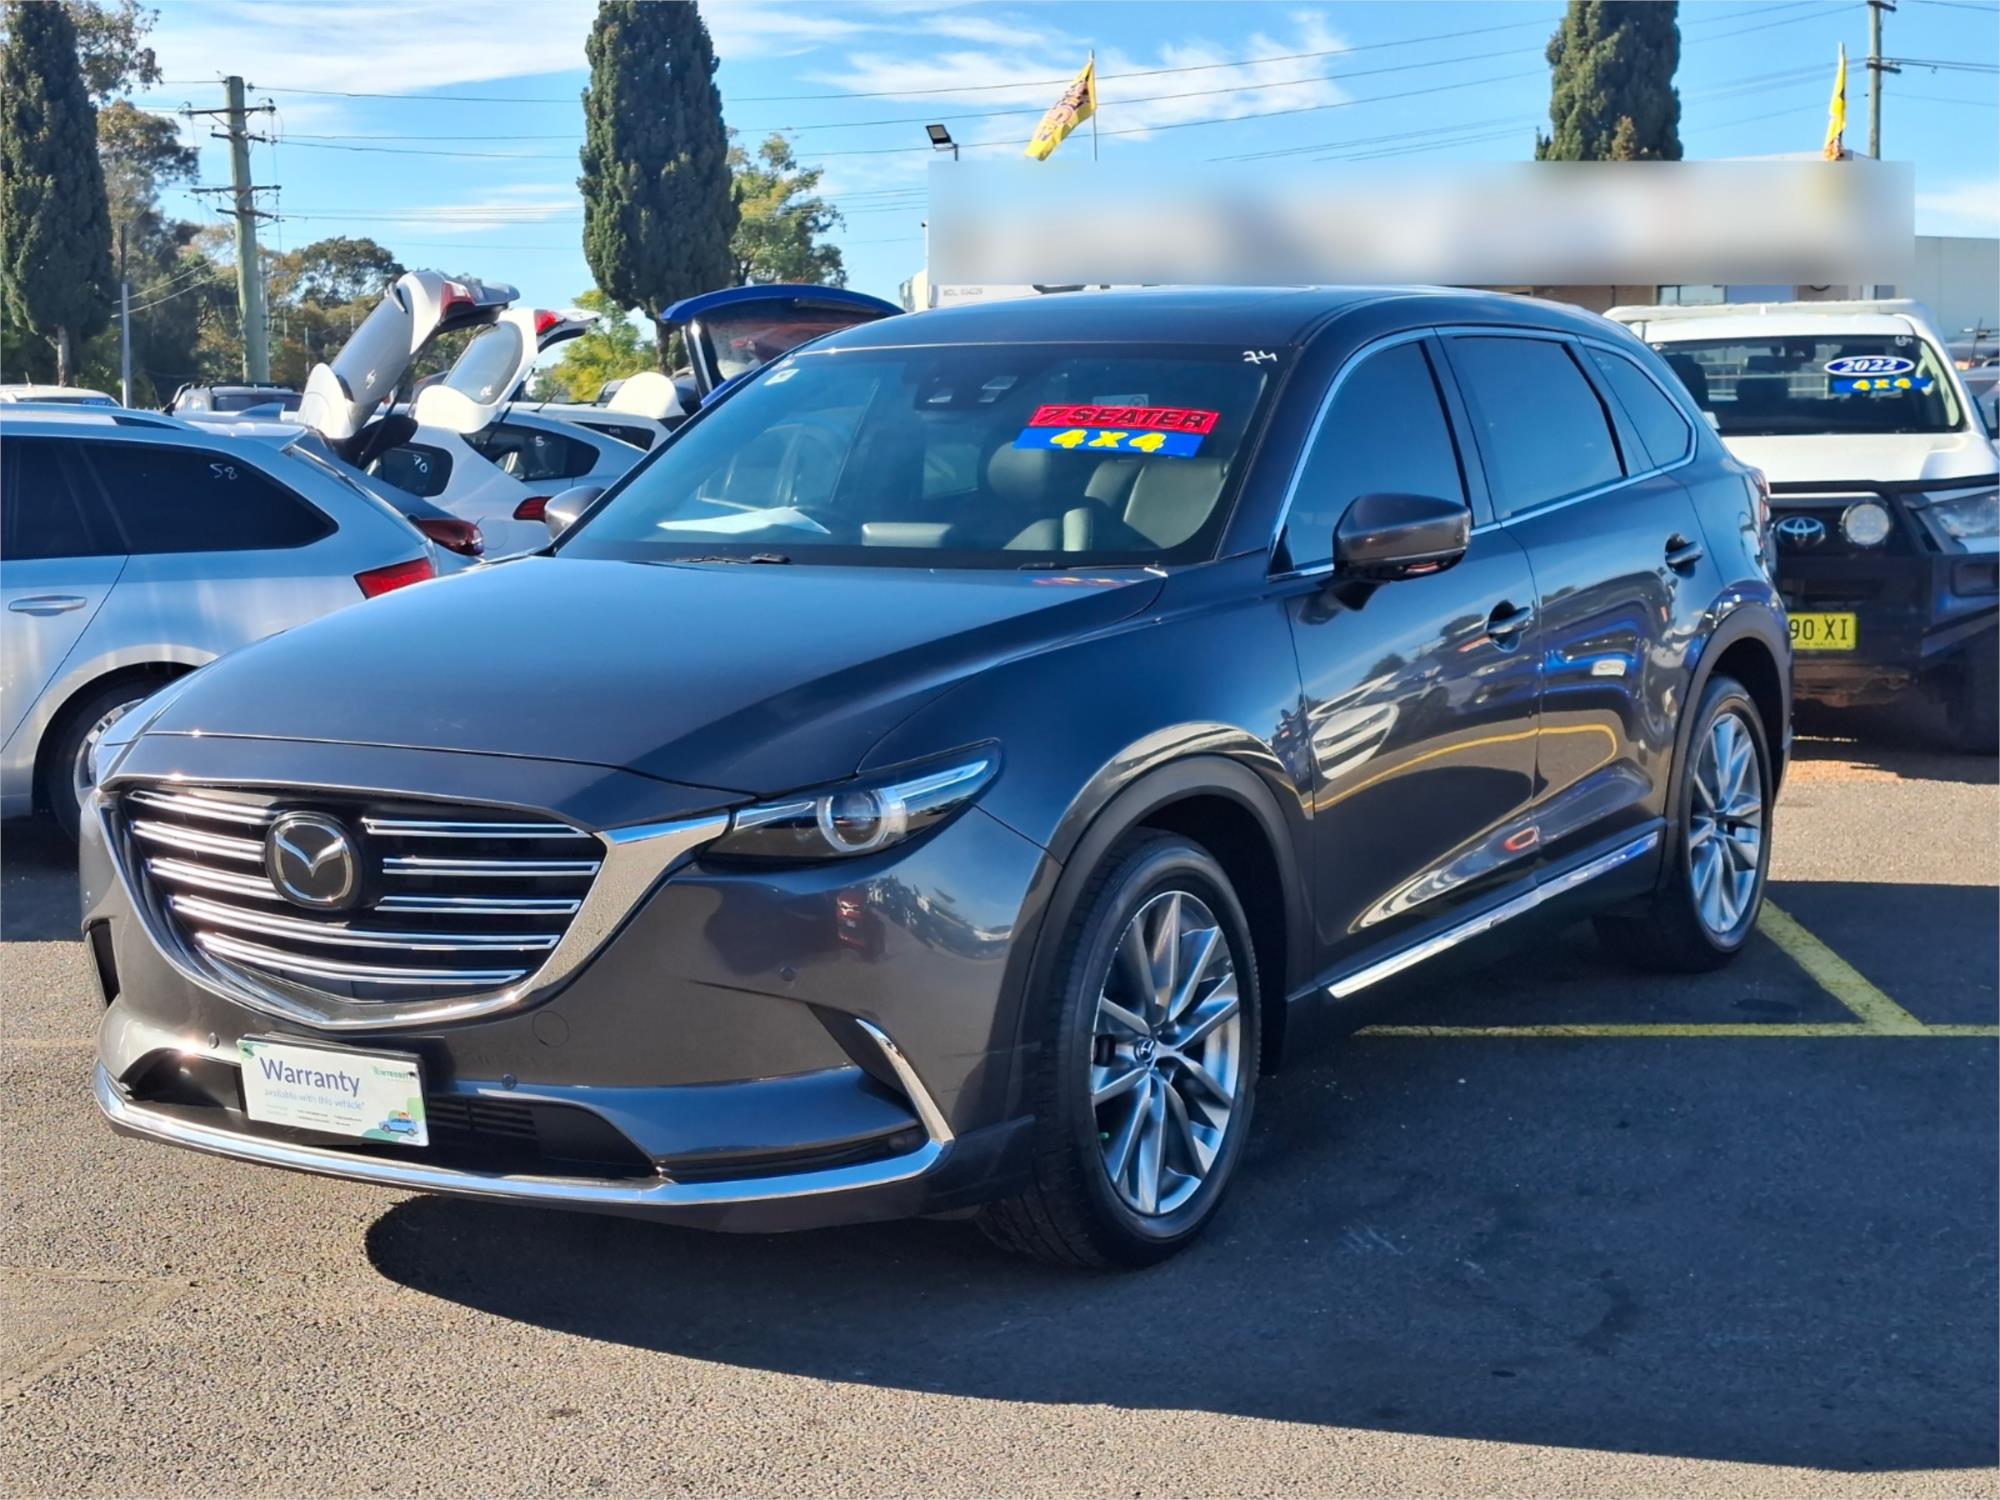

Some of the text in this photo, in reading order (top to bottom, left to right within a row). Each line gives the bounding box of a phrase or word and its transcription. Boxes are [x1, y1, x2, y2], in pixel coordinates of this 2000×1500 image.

[1840, 359, 1898, 372] 2022
[1038, 407, 1207, 429] 7 SEATER
[209, 463, 238, 480] 58
[259, 1057, 360, 1097] Warranty
